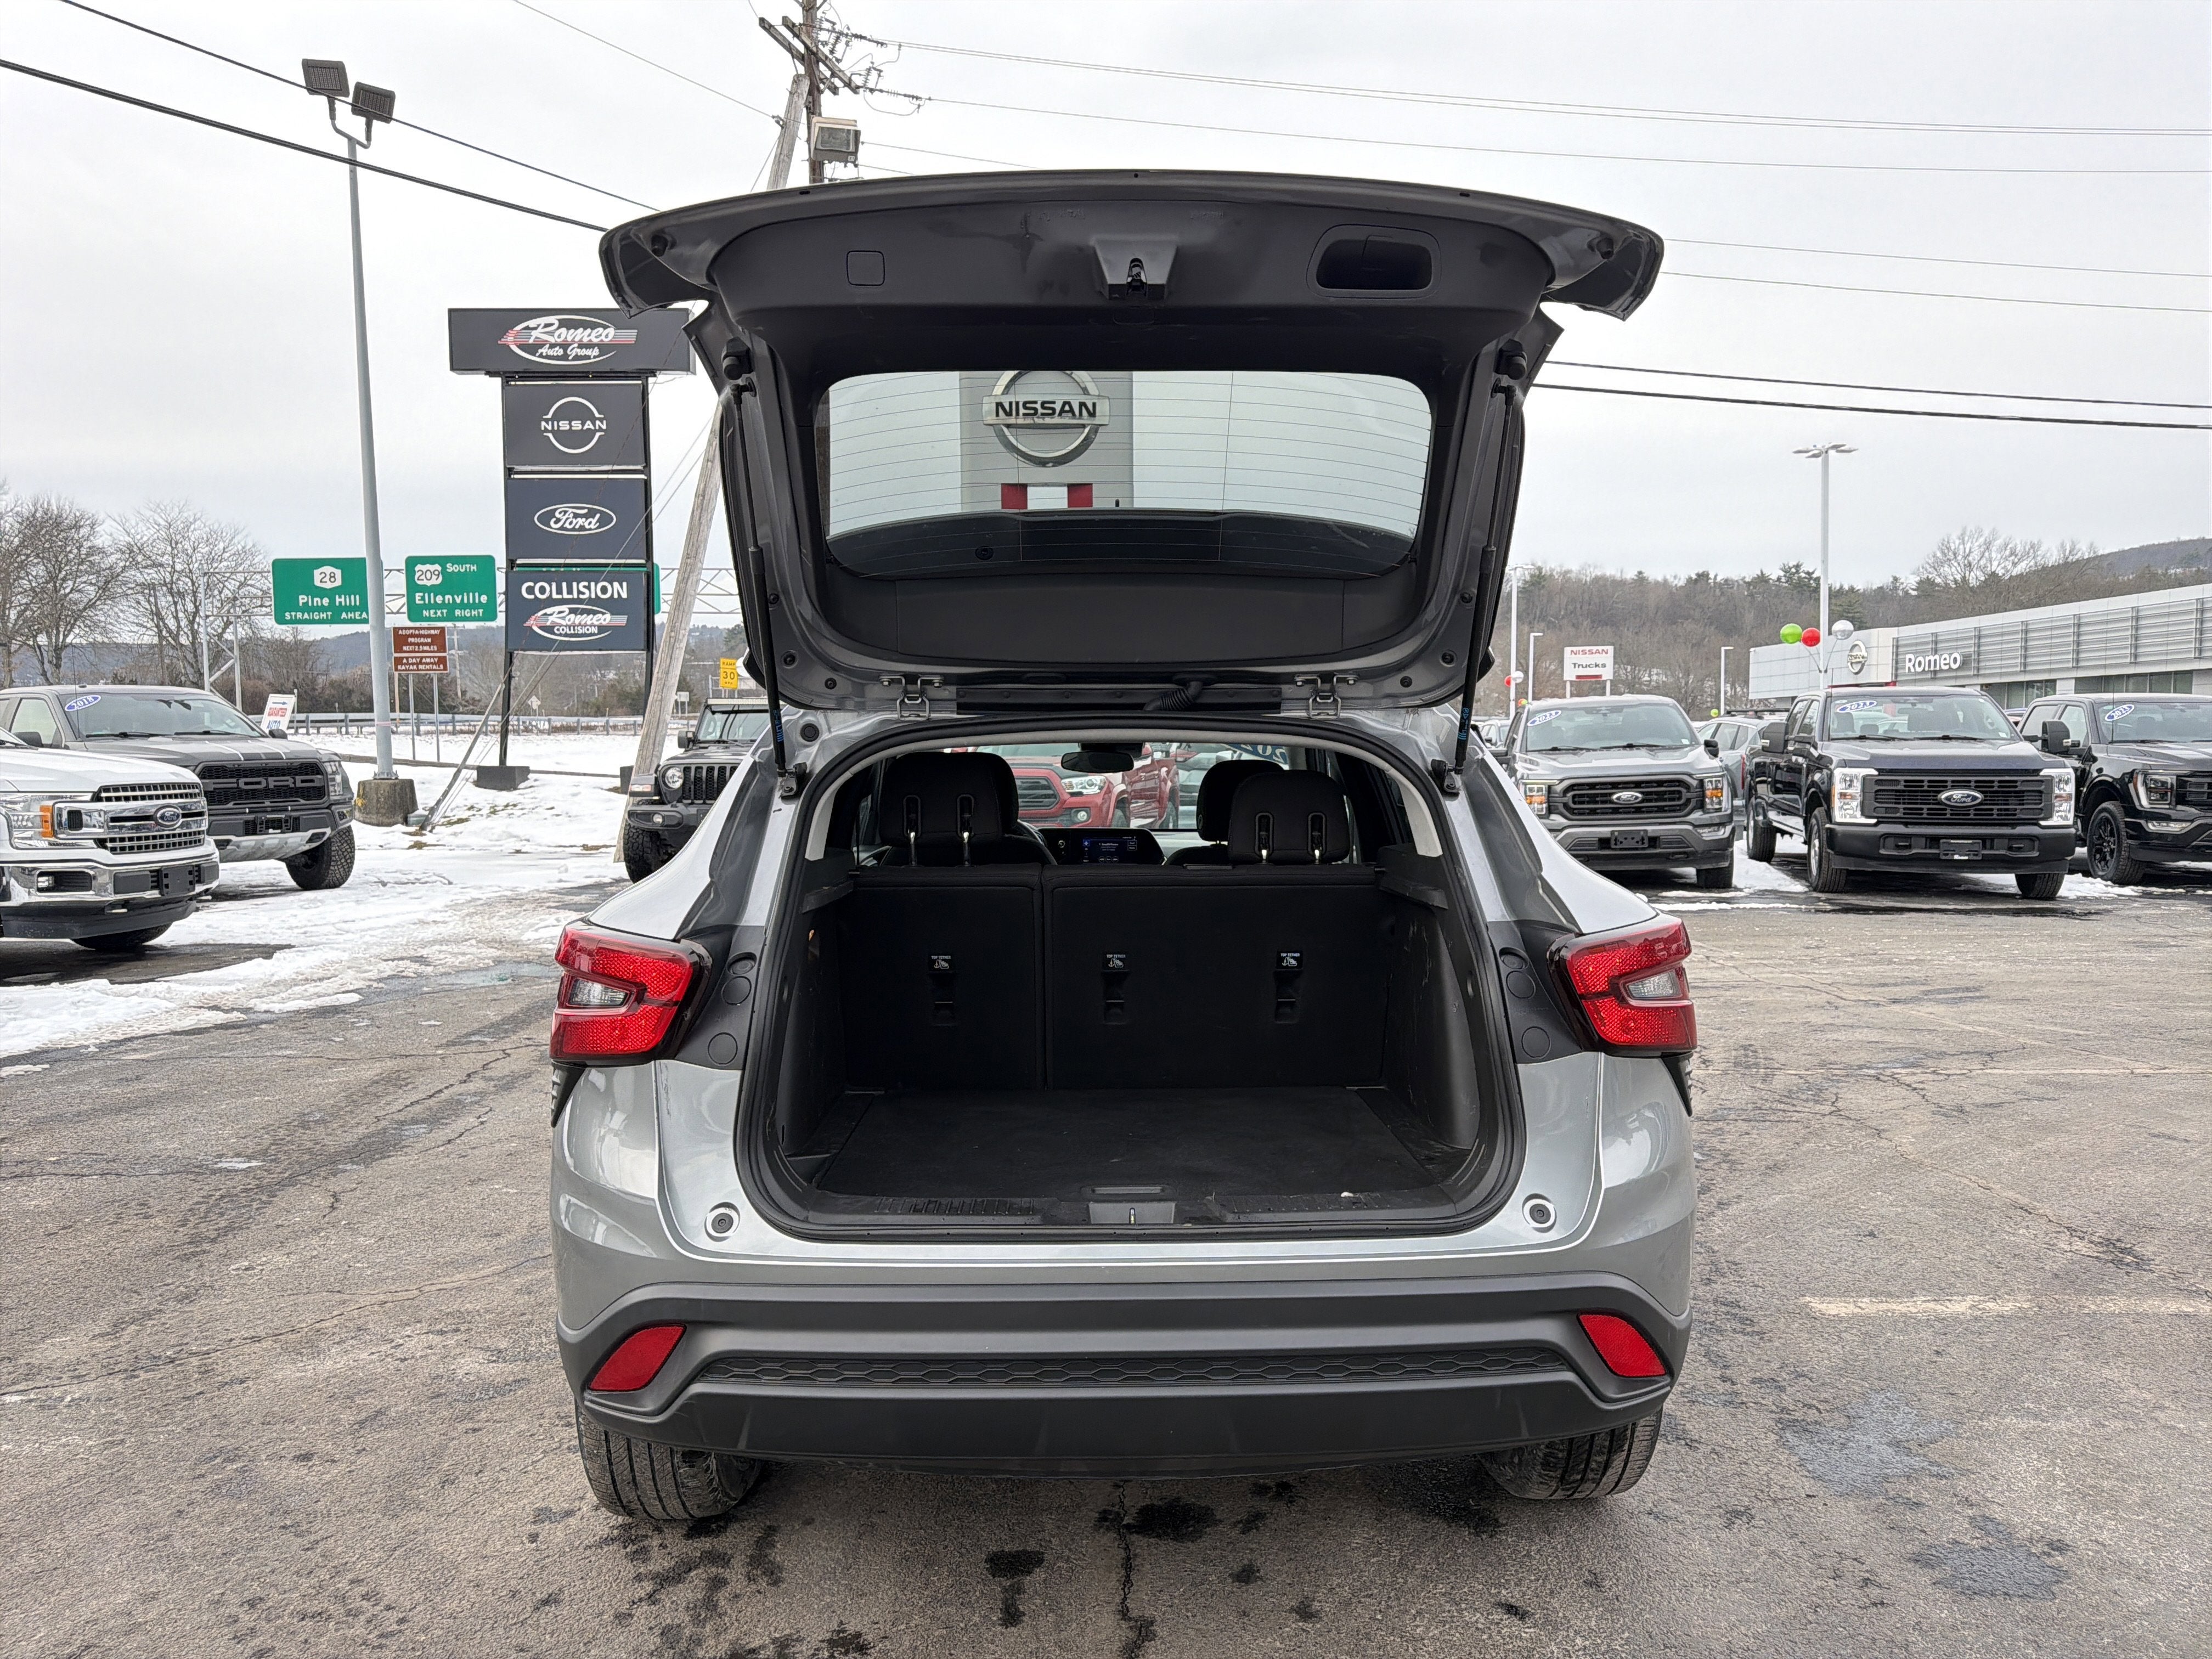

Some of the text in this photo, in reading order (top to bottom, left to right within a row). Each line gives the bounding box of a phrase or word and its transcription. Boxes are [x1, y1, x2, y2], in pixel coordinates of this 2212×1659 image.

[527, 317, 616, 343] Romeo
[536, 343, 600, 359] Auto Group
[995, 400, 1097, 418] NISSAN
[541, 420, 607, 431] NISSAN
[550, 507, 600, 530] Ford
[446, 563, 477, 572] SOUTH
[319, 571, 337, 584] 28
[416, 569, 440, 582] 209
[521, 581, 628, 599] COLLISION
[298, 595, 360, 607] Pine Hill
[415, 592, 488, 604] Ellenville
[285, 611, 368, 620] STRAIGHT AHEA
[422, 608, 484, 618] NEXT RIGHT
[546, 607, 611, 626] Romeo
[554, 625, 598, 634] COLLISION
[1905, 652, 1961, 673] Romeo
[723, 670, 735, 680] 30
[71, 696, 94, 709] 2018
[2110, 706, 2130, 719] 2023
[200, 775, 325, 791] FORD
[1950, 794, 1973, 803] Ford
